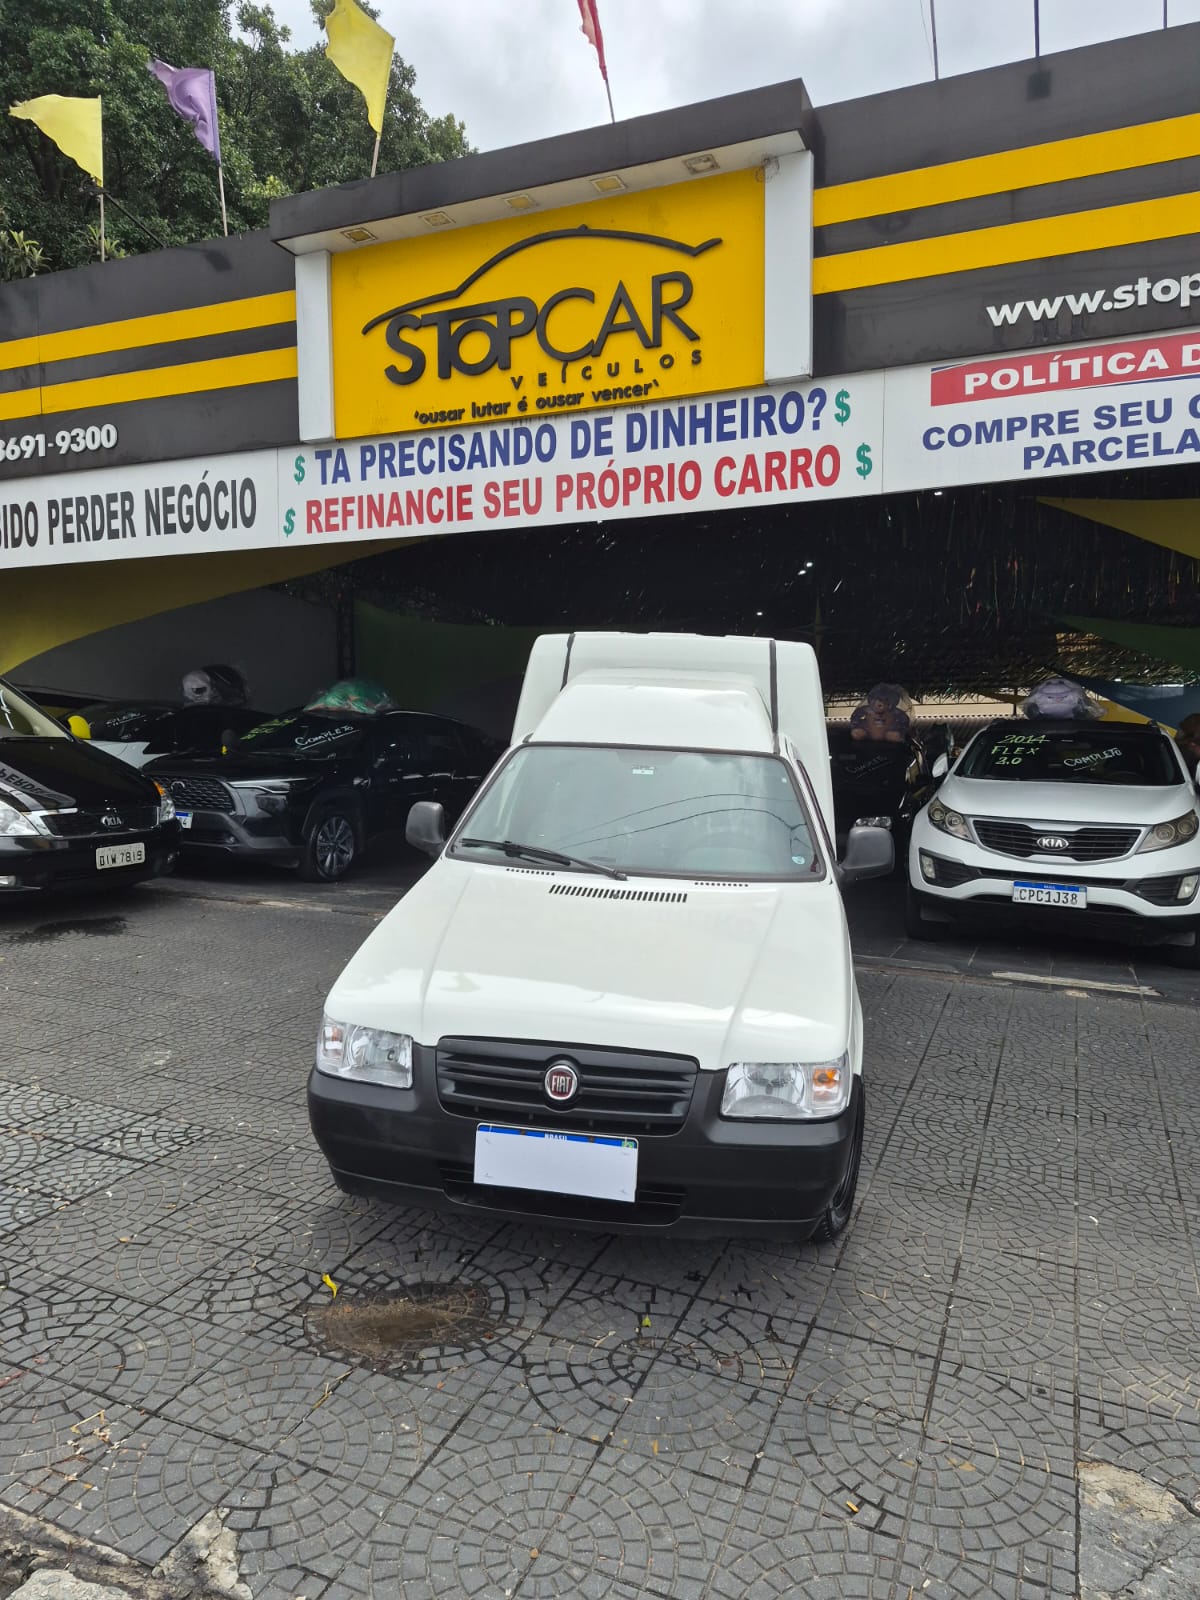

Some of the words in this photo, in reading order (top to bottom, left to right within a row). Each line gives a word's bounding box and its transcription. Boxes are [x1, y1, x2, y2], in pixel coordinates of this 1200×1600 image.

[986, 272, 1200, 327] www.stop
[384, 270, 701, 386] STOPCAR
[511, 349, 702, 391] VEÍCULOS
[964, 348, 1169, 396] POLÍTICA
[471, 401, 510, 419] lutar
[517, 396, 528, 412] é
[536, 391, 584, 408] ousar
[922, 409, 1080, 451] COMPRE
[1093, 398, 1173, 430] SEU
[315, 448, 351, 485] TA
[360, 423, 557, 482] PRECISANDO
[570, 416, 613, 459] DE
[626, 387, 827, 453] DINHEIRO?
[834, 388, 851, 426] $
[1023, 428, 1200, 470] PARCELA
[0, 500, 39, 549] IDO
[47, 490, 137, 546] PERDER
[144, 470, 257, 536] NEGÓCIO
[306, 484, 473, 534] REFINANCIE
[483, 477, 542, 519] SEU
[555, 460, 701, 513] PRÓPRIO
[714, 444, 841, 497] CARRO
[855, 442, 873, 480] $
[991, 746, 1040, 755] FLEX
[1042, 838, 1063, 848] KIA
[1019, 888, 1078, 905] CPC1J38
[551, 1075, 571, 1093] FIAT
